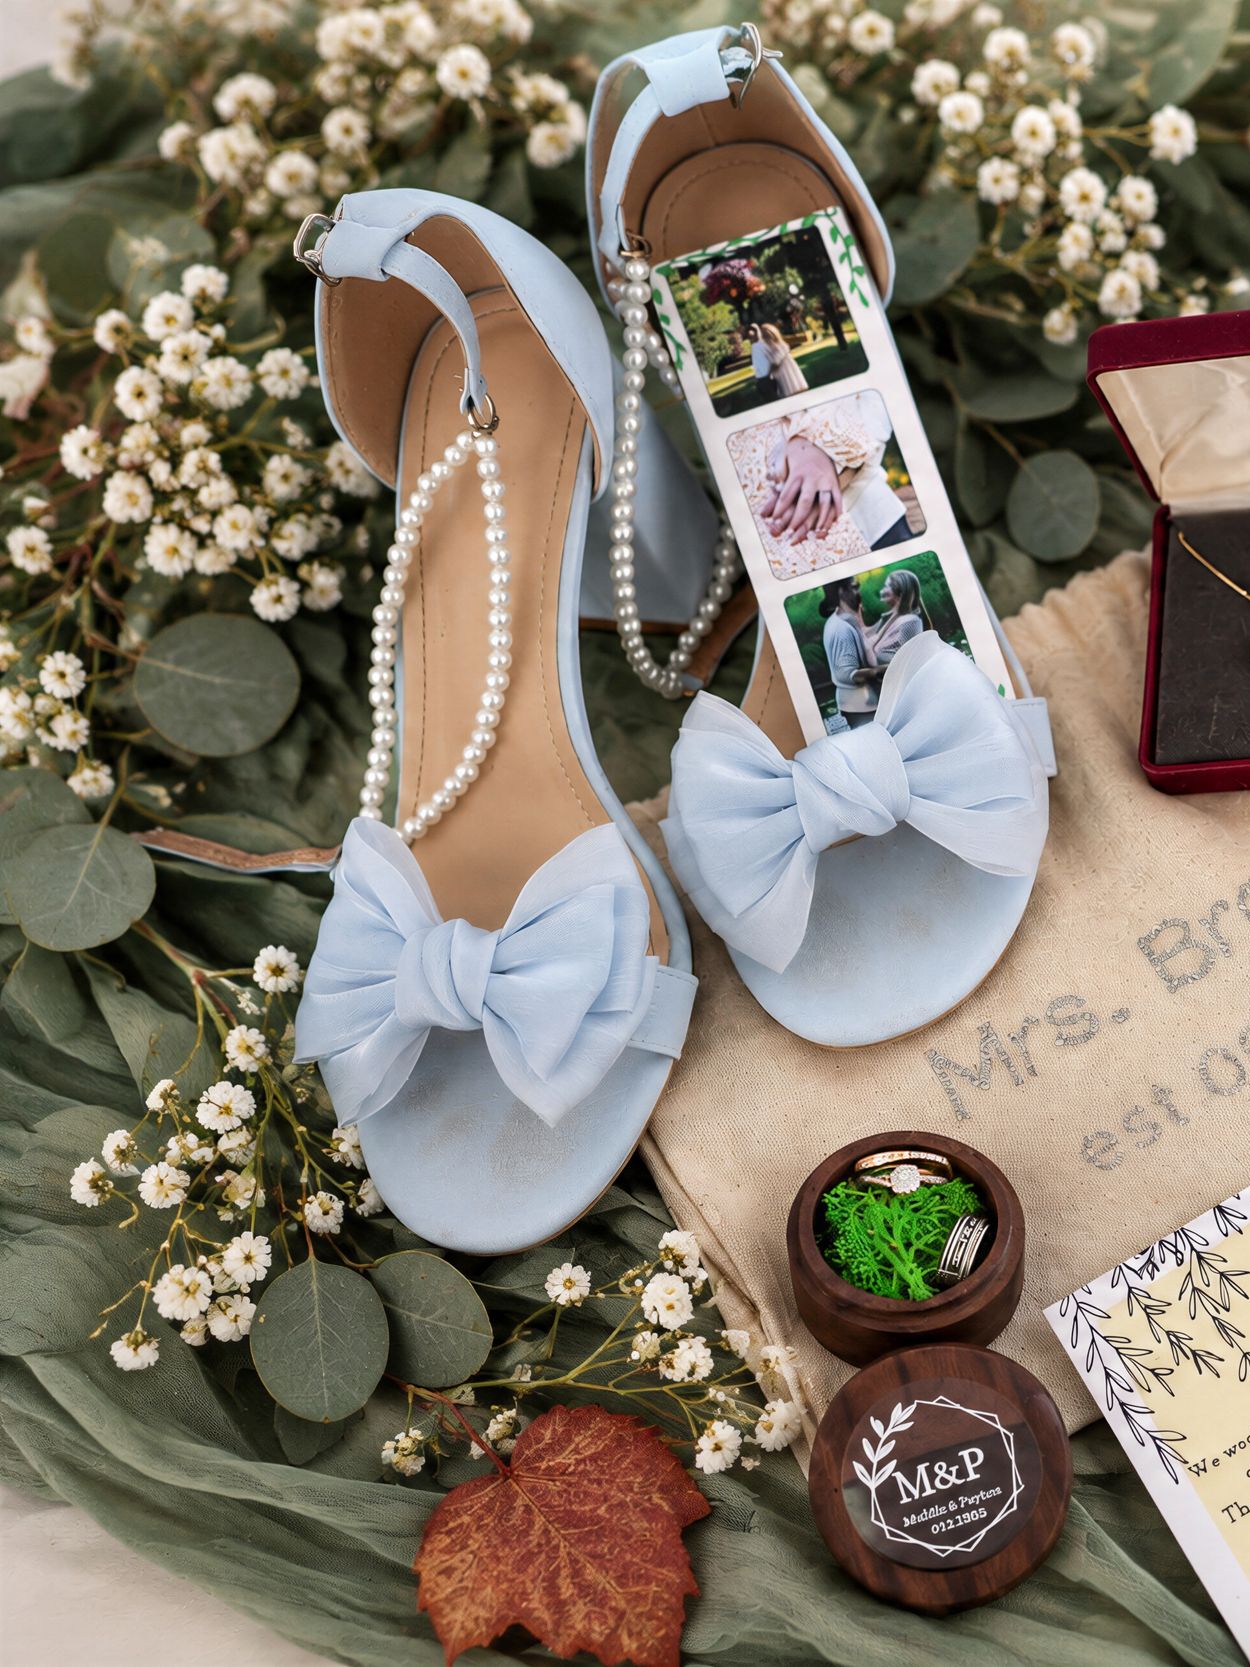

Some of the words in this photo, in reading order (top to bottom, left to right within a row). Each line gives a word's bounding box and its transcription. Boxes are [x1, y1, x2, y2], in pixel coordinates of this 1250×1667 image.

[925, 994, 1130, 1121] Mrs.
[1080, 1083, 1190, 1171] est
[891, 1447, 985, 1504] M&P
[1187, 1457, 1221, 1478] We
